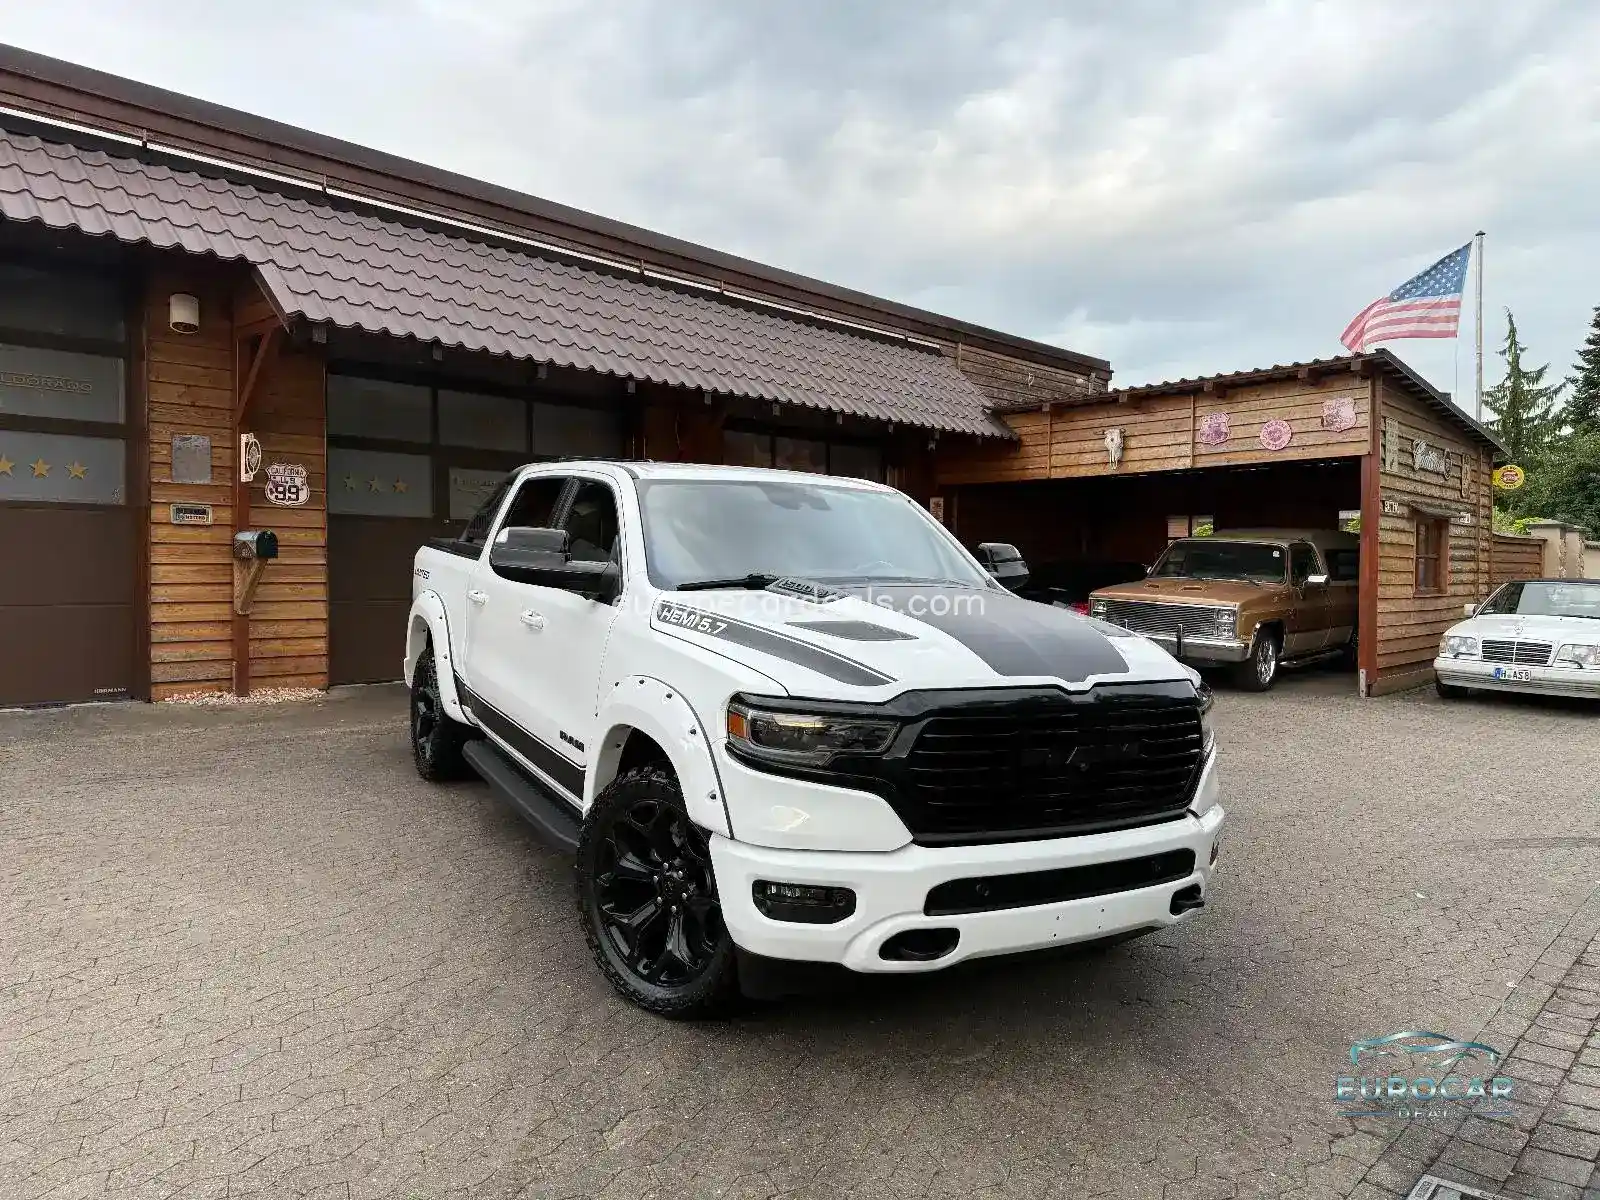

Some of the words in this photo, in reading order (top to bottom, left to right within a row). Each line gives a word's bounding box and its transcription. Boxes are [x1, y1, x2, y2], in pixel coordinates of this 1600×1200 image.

[274, 485, 299, 501] 99
[660, 607, 700, 628] HEMI
[559, 730, 585, 753] RAM
